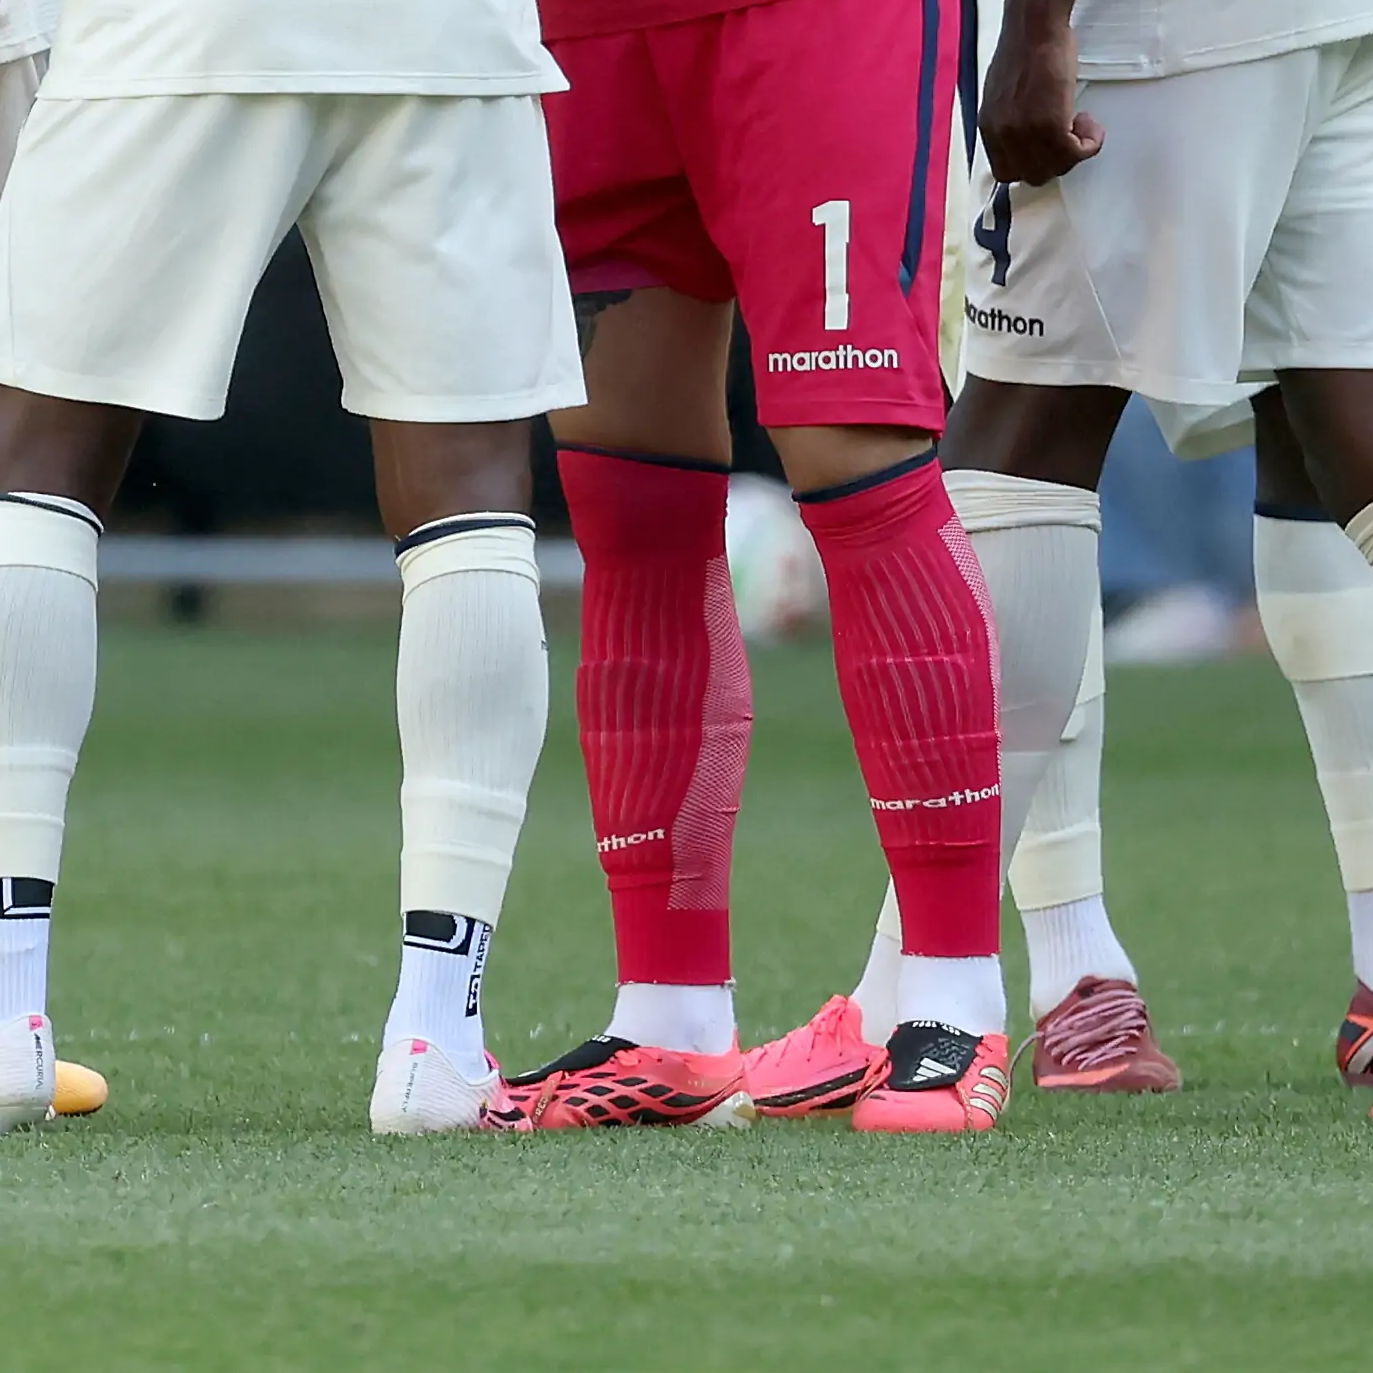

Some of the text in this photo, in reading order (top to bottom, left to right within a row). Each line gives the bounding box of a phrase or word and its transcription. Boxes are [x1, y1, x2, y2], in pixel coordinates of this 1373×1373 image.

[812, 200, 850, 330] 1
[974, 181, 1011, 286] 4
[768, 345, 898, 372] marathon
